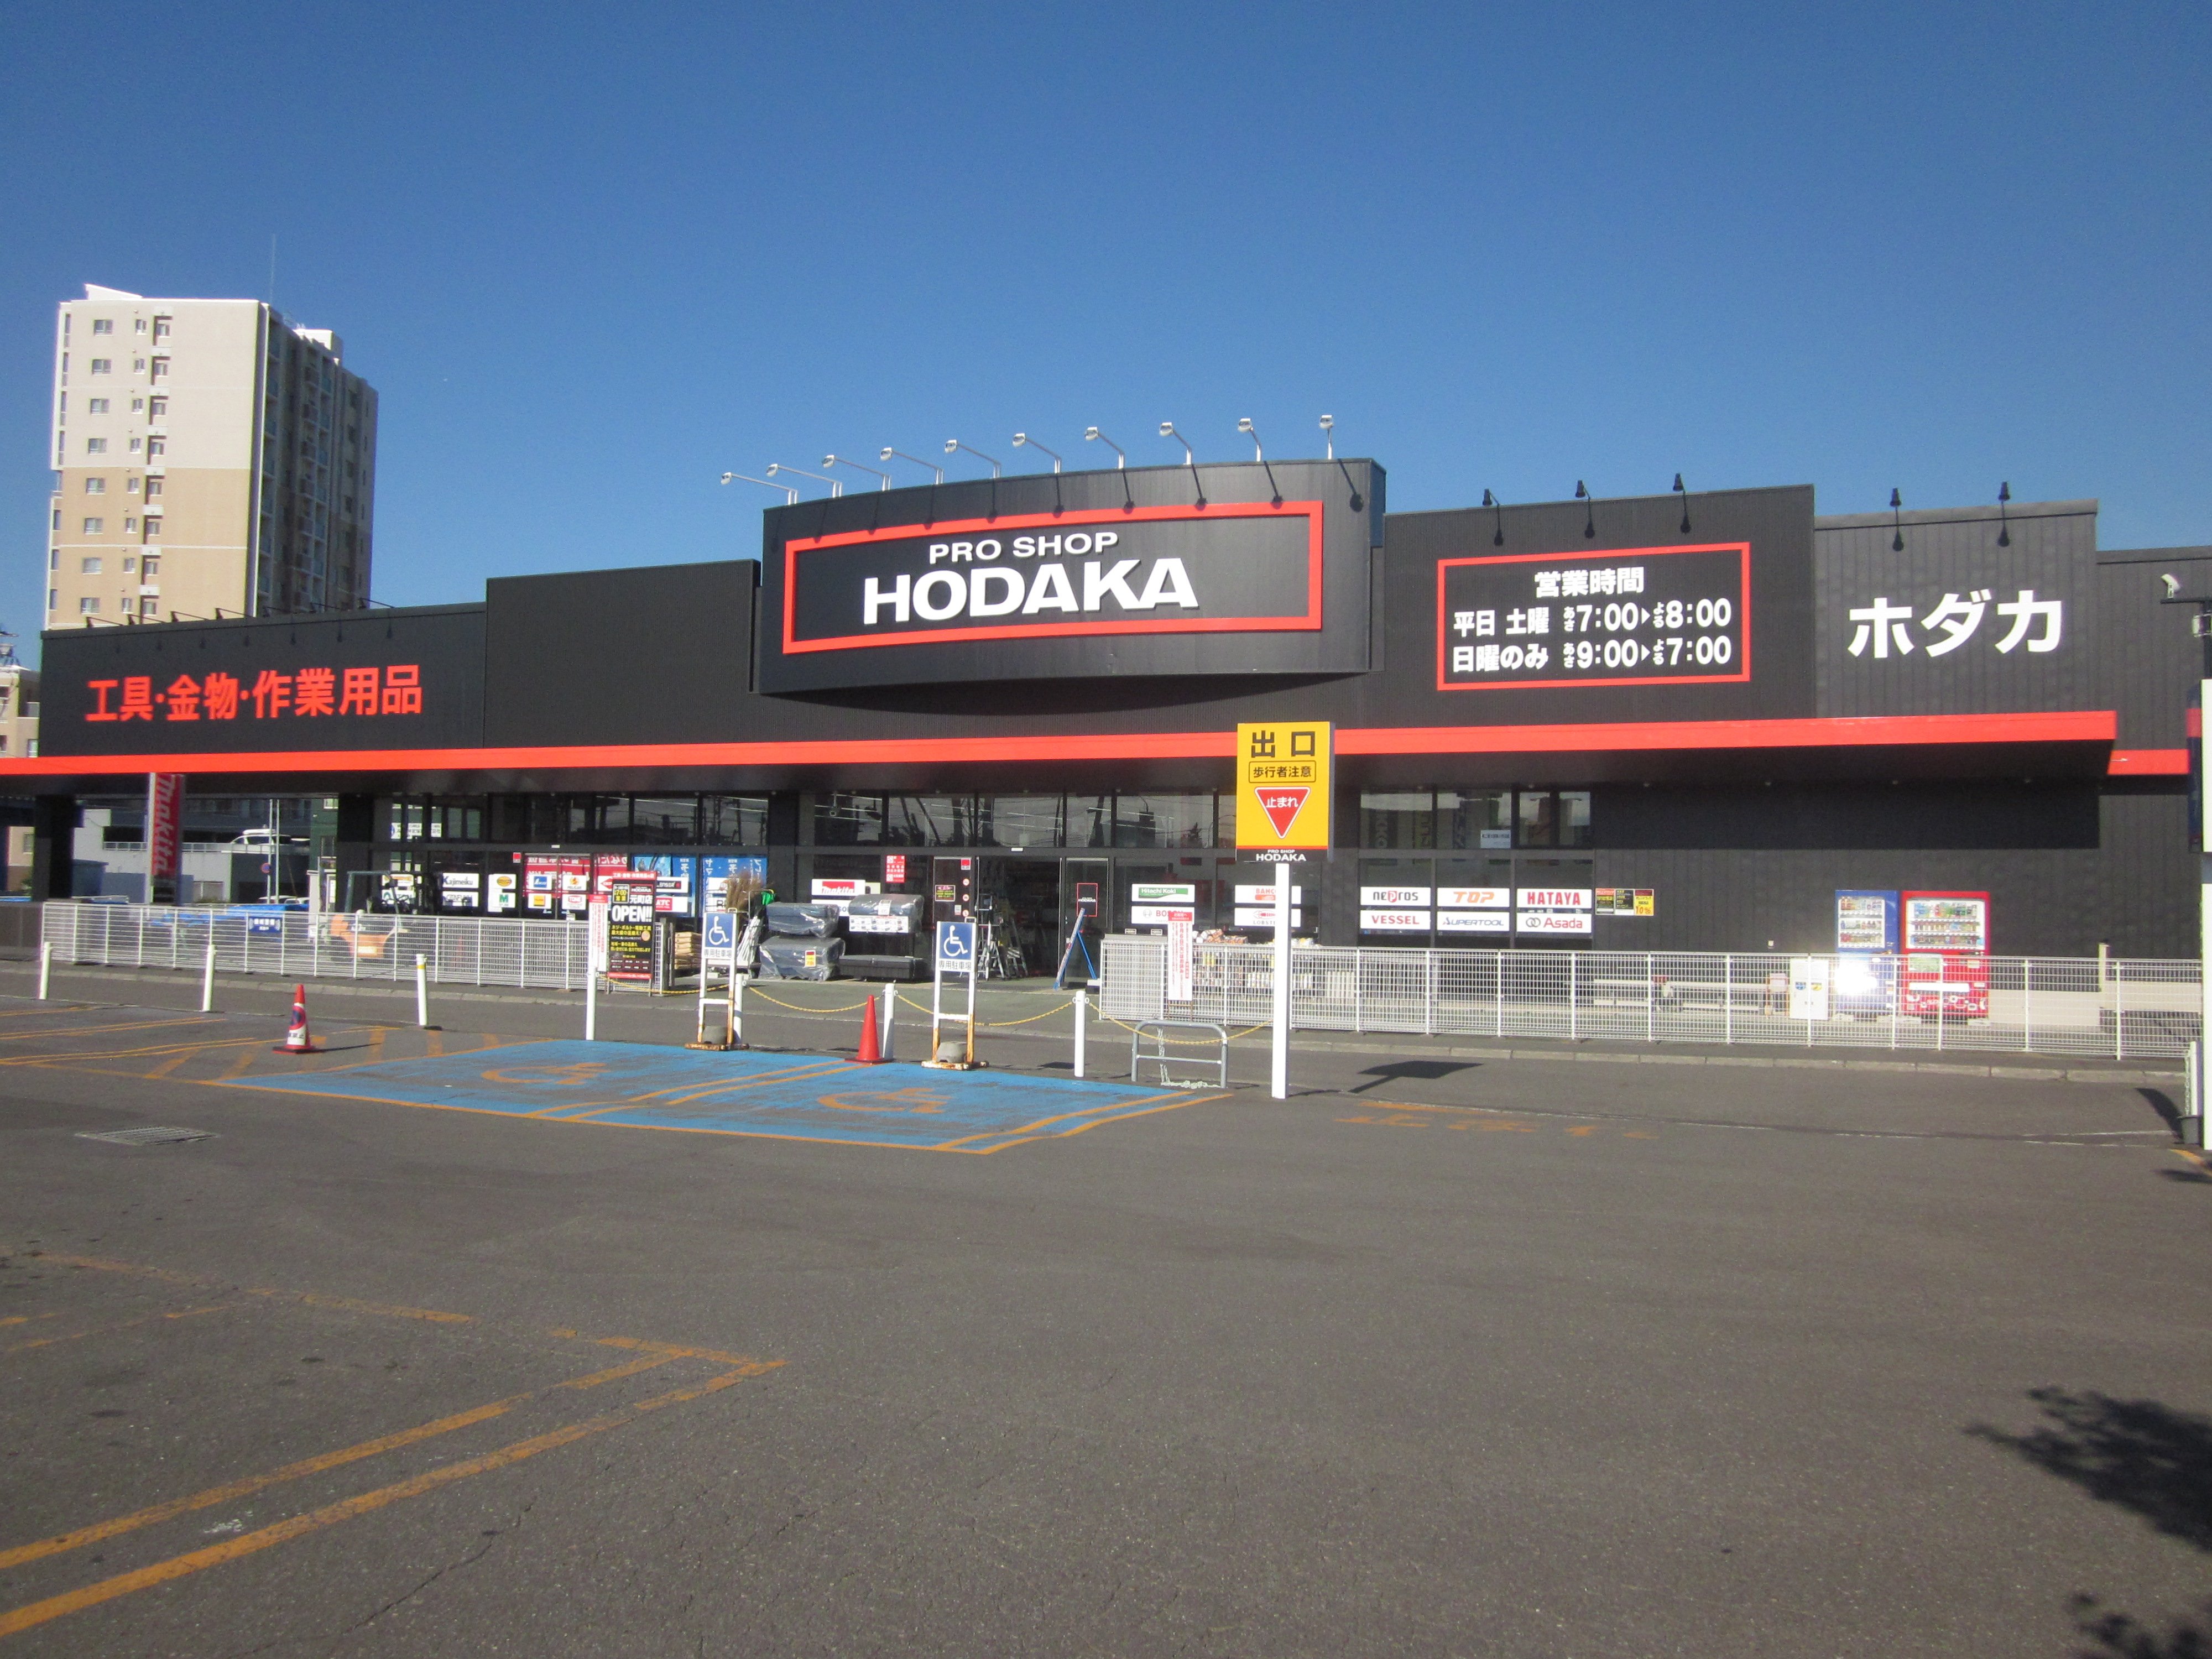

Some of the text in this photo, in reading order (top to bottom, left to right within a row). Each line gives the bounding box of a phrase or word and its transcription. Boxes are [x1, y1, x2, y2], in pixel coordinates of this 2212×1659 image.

[930, 531, 1118, 565] PRO SHOP
[1535, 567, 1645, 598] 営業時間
[864, 557, 1200, 625] HODAKA
[1453, 610, 1495, 637] 平日
[1505, 607, 1550, 635] 土曜
[1577, 602, 1639, 632] 7:00
[1665, 598, 1731, 628] 8:00
[1848, 588, 2062, 658] ホダカ
[1453, 643, 1549, 672] 日曜のみ
[1577, 639, 1639, 668] 9:00
[1666, 635, 1731, 665] 7:00
[1251, 730, 1316, 758] 出口
[1253, 766, 1312, 778] 歩行者注意
[1266, 797, 1298, 808] 止まれ
[630, 895, 653, 904] 元町店
[1373, 891, 1418, 902] nepros
[1453, 891, 1495, 903] TOP
[1527, 892, 1581, 905] HATAYA
[612, 905, 652, 922] OPEN!!
[1371, 915, 1420, 925] VESSEL
[1443, 917, 1504, 926] SUPERTOOL
[1543, 917, 1583, 928] Asada
[939, 961, 972, 970] 専用駐車場
